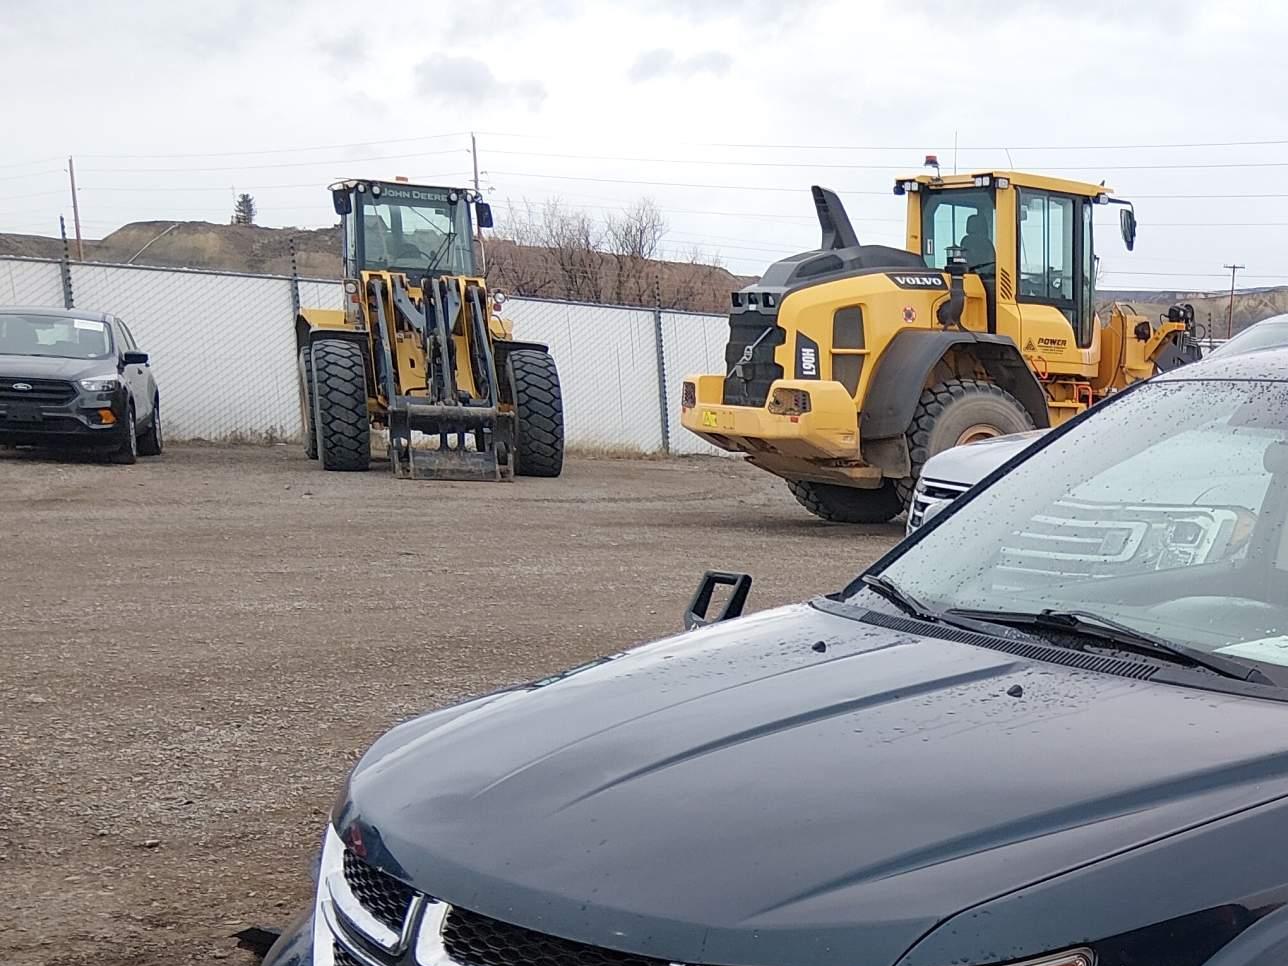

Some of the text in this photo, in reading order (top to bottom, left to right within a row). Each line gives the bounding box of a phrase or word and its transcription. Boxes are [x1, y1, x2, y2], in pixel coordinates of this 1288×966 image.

[382, 187, 448, 202] JOHN DEERE
[895, 276, 943, 286] VOLVO
[1038, 337, 1067, 346] POWER
[801, 347, 816, 376] L90H
